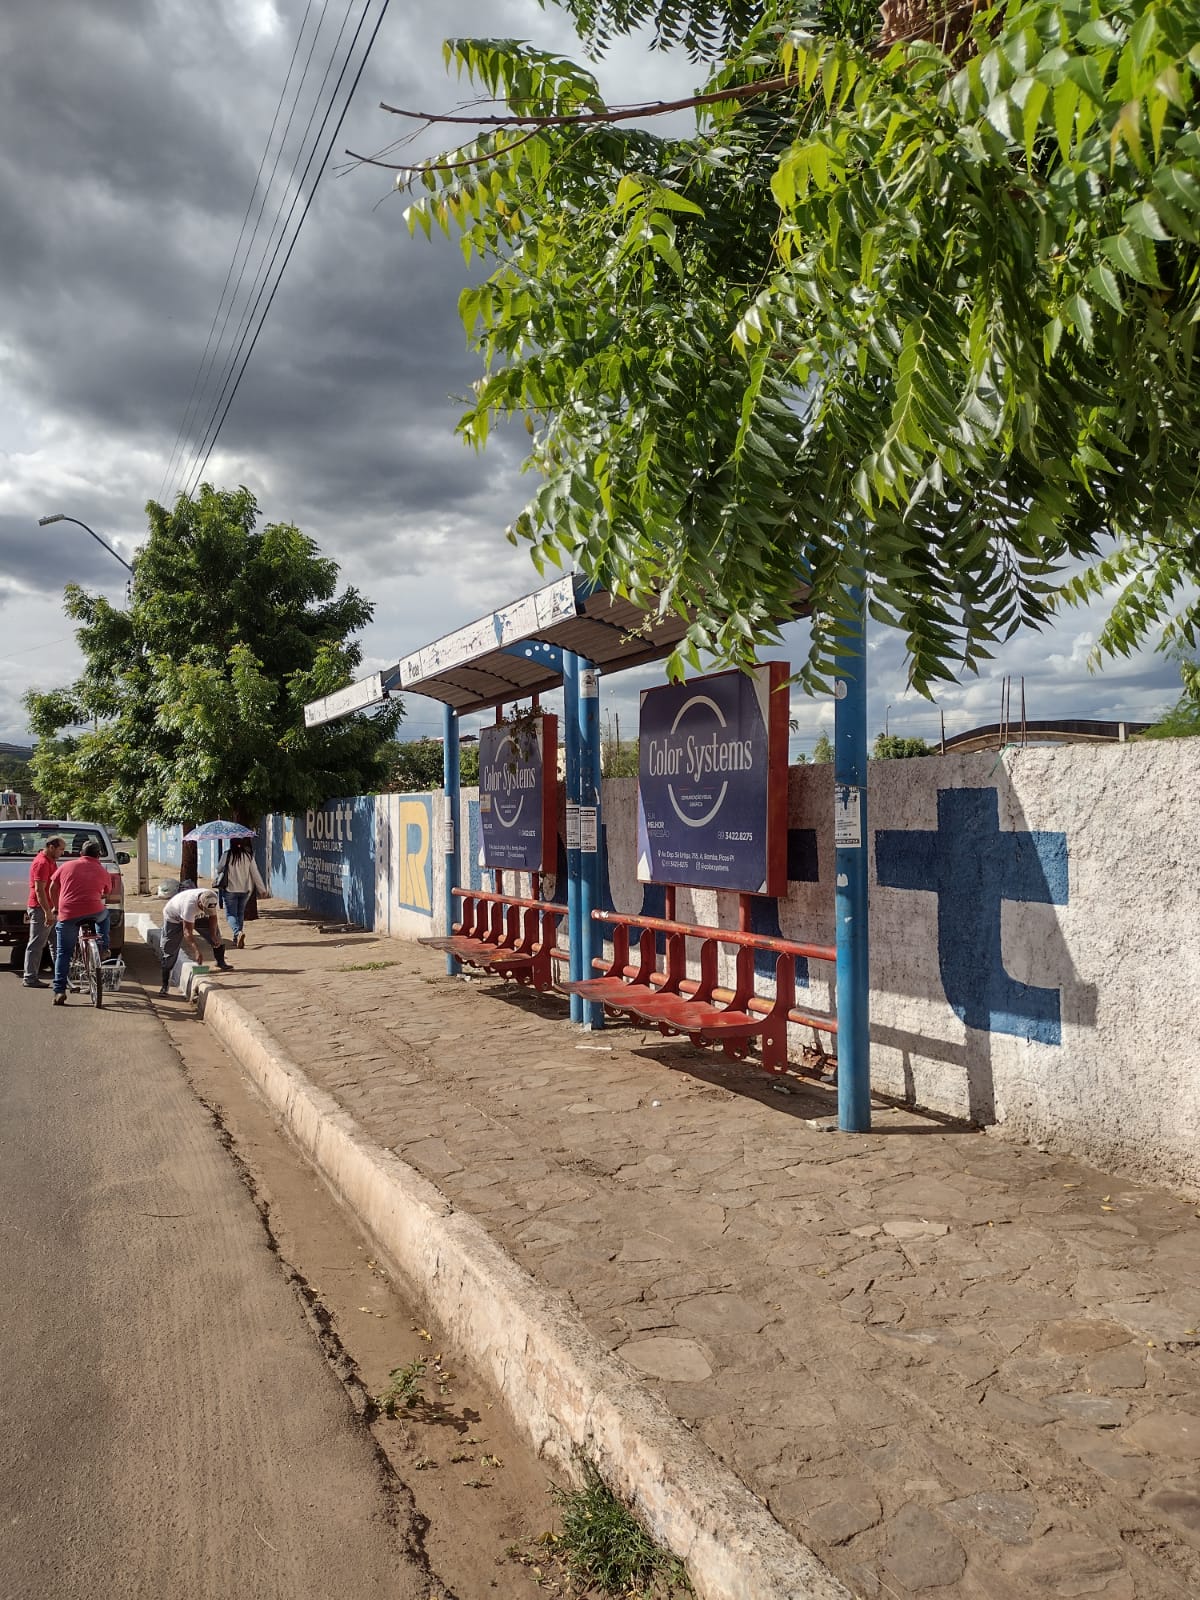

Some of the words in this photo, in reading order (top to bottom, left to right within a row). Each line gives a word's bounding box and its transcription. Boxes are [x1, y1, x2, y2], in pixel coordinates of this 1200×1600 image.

[649, 736, 683, 777] Color
[686, 732, 753, 783] Systems
[484, 764, 502, 792] Color
[503, 763, 536, 796] Systems
[306, 803, 353, 841] Routt
[647, 821, 665, 829] MELHOR
[399, 800, 431, 911] R
